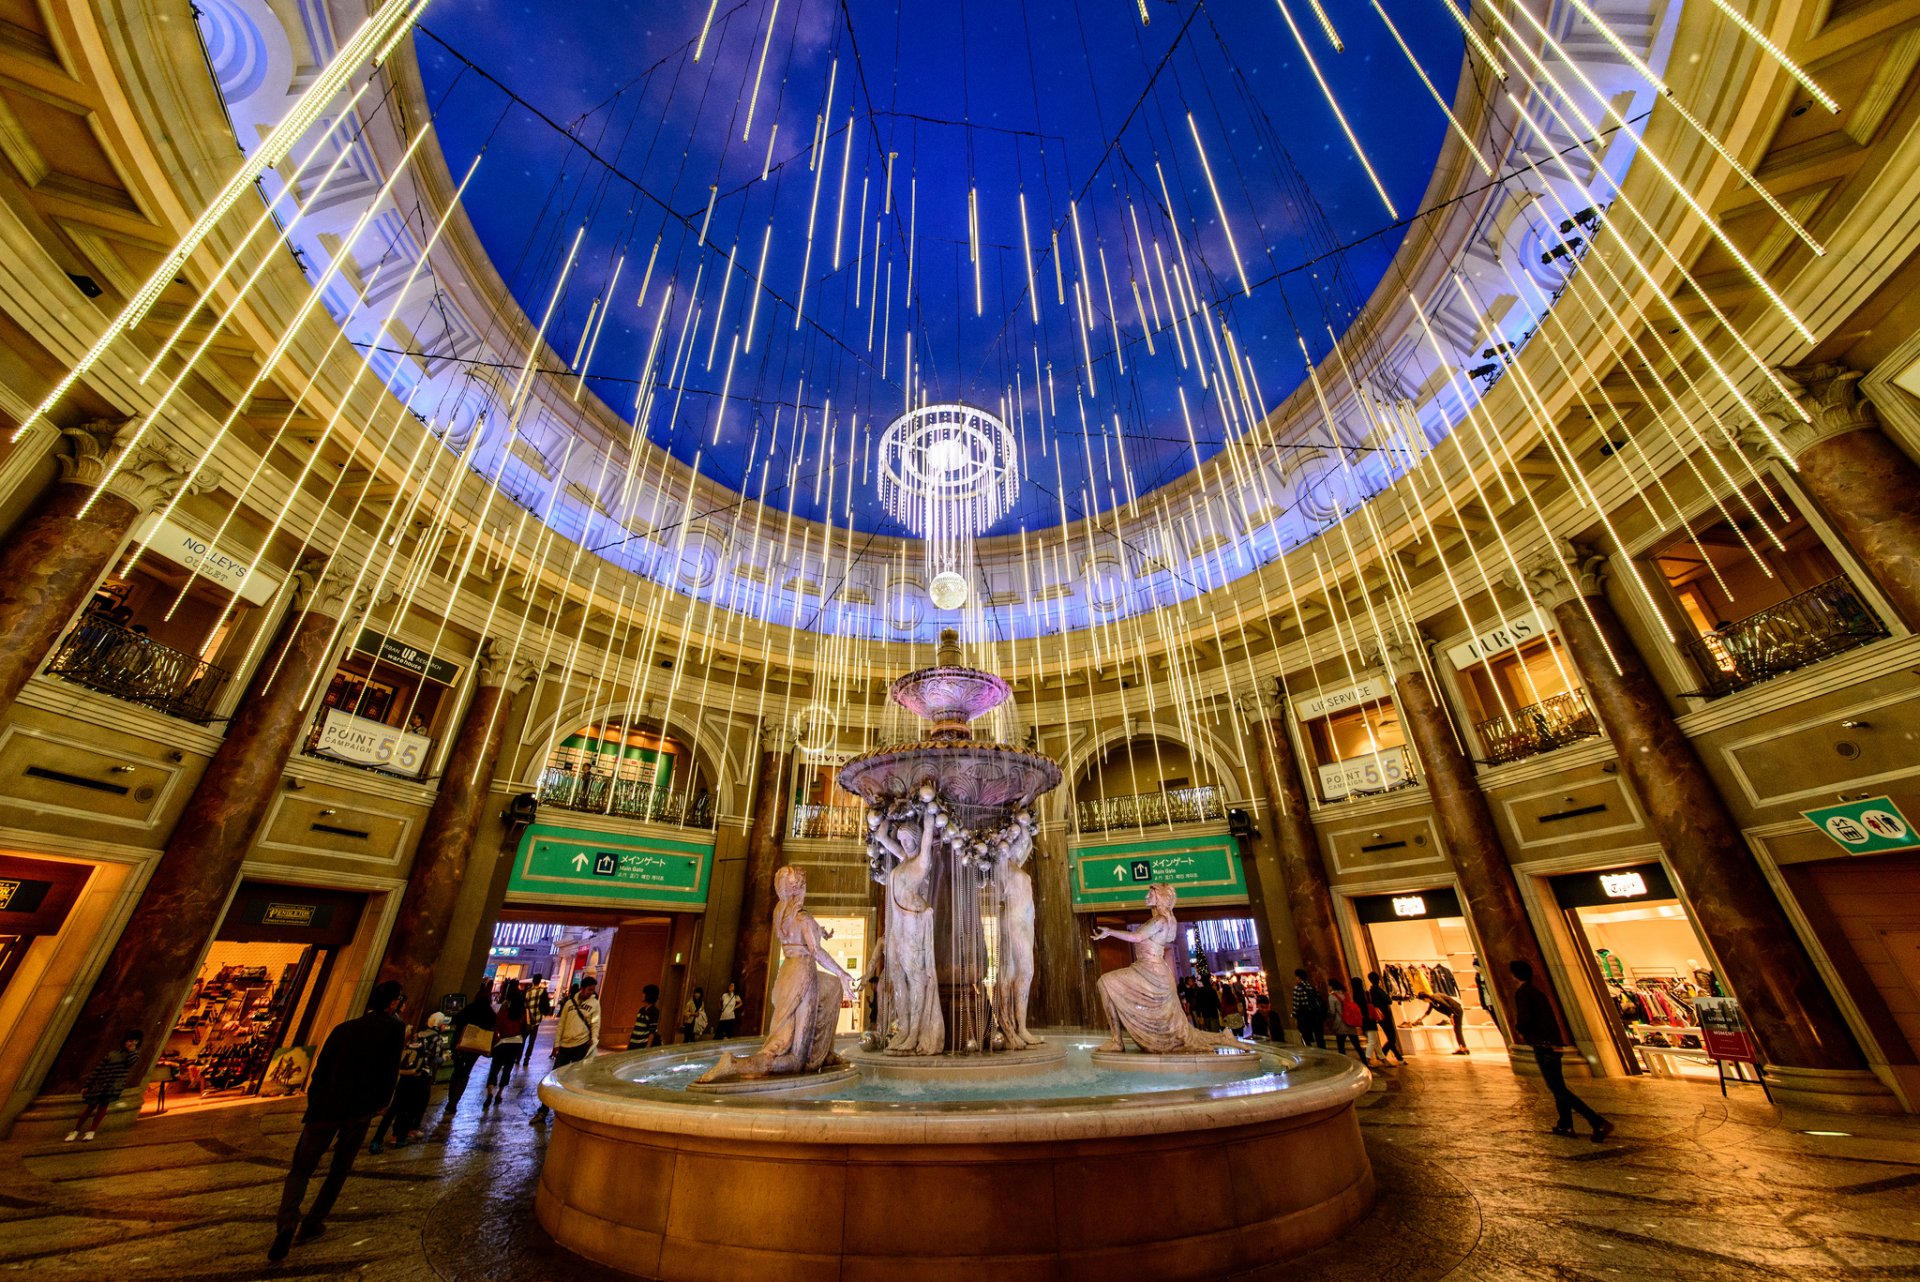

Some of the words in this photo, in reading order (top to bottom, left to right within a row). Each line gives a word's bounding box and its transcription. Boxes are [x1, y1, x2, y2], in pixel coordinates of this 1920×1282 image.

[184, 556, 228, 582] OUTLET
[387, 653, 422, 671] warehouse
[401, 646, 417, 662] UR
[324, 736, 372, 754] CAMPAIGN
[327, 726, 376, 747] POINT
[1326, 770, 1360, 785] PONT
[620, 855, 666, 867] メインゲート
[1152, 857, 1195, 868] メインゲート
